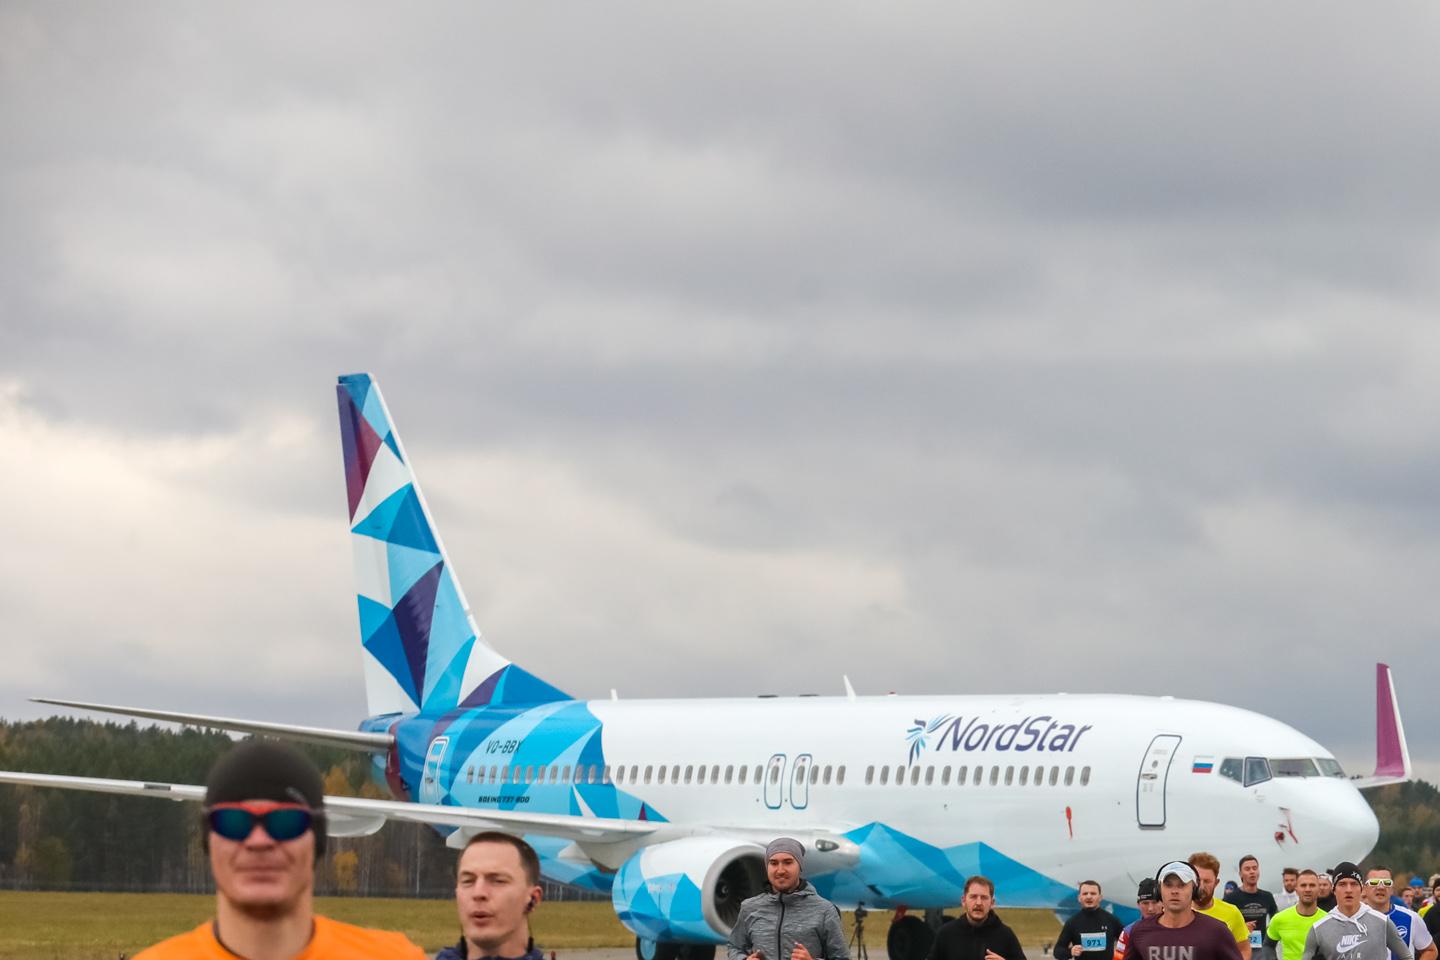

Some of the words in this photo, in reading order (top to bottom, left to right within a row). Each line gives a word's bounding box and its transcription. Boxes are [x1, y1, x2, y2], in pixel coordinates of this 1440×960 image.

[936, 716, 1093, 752] NordStar
[1086, 939, 1102, 947] 971
[1341, 935, 1361, 945] NIKE
